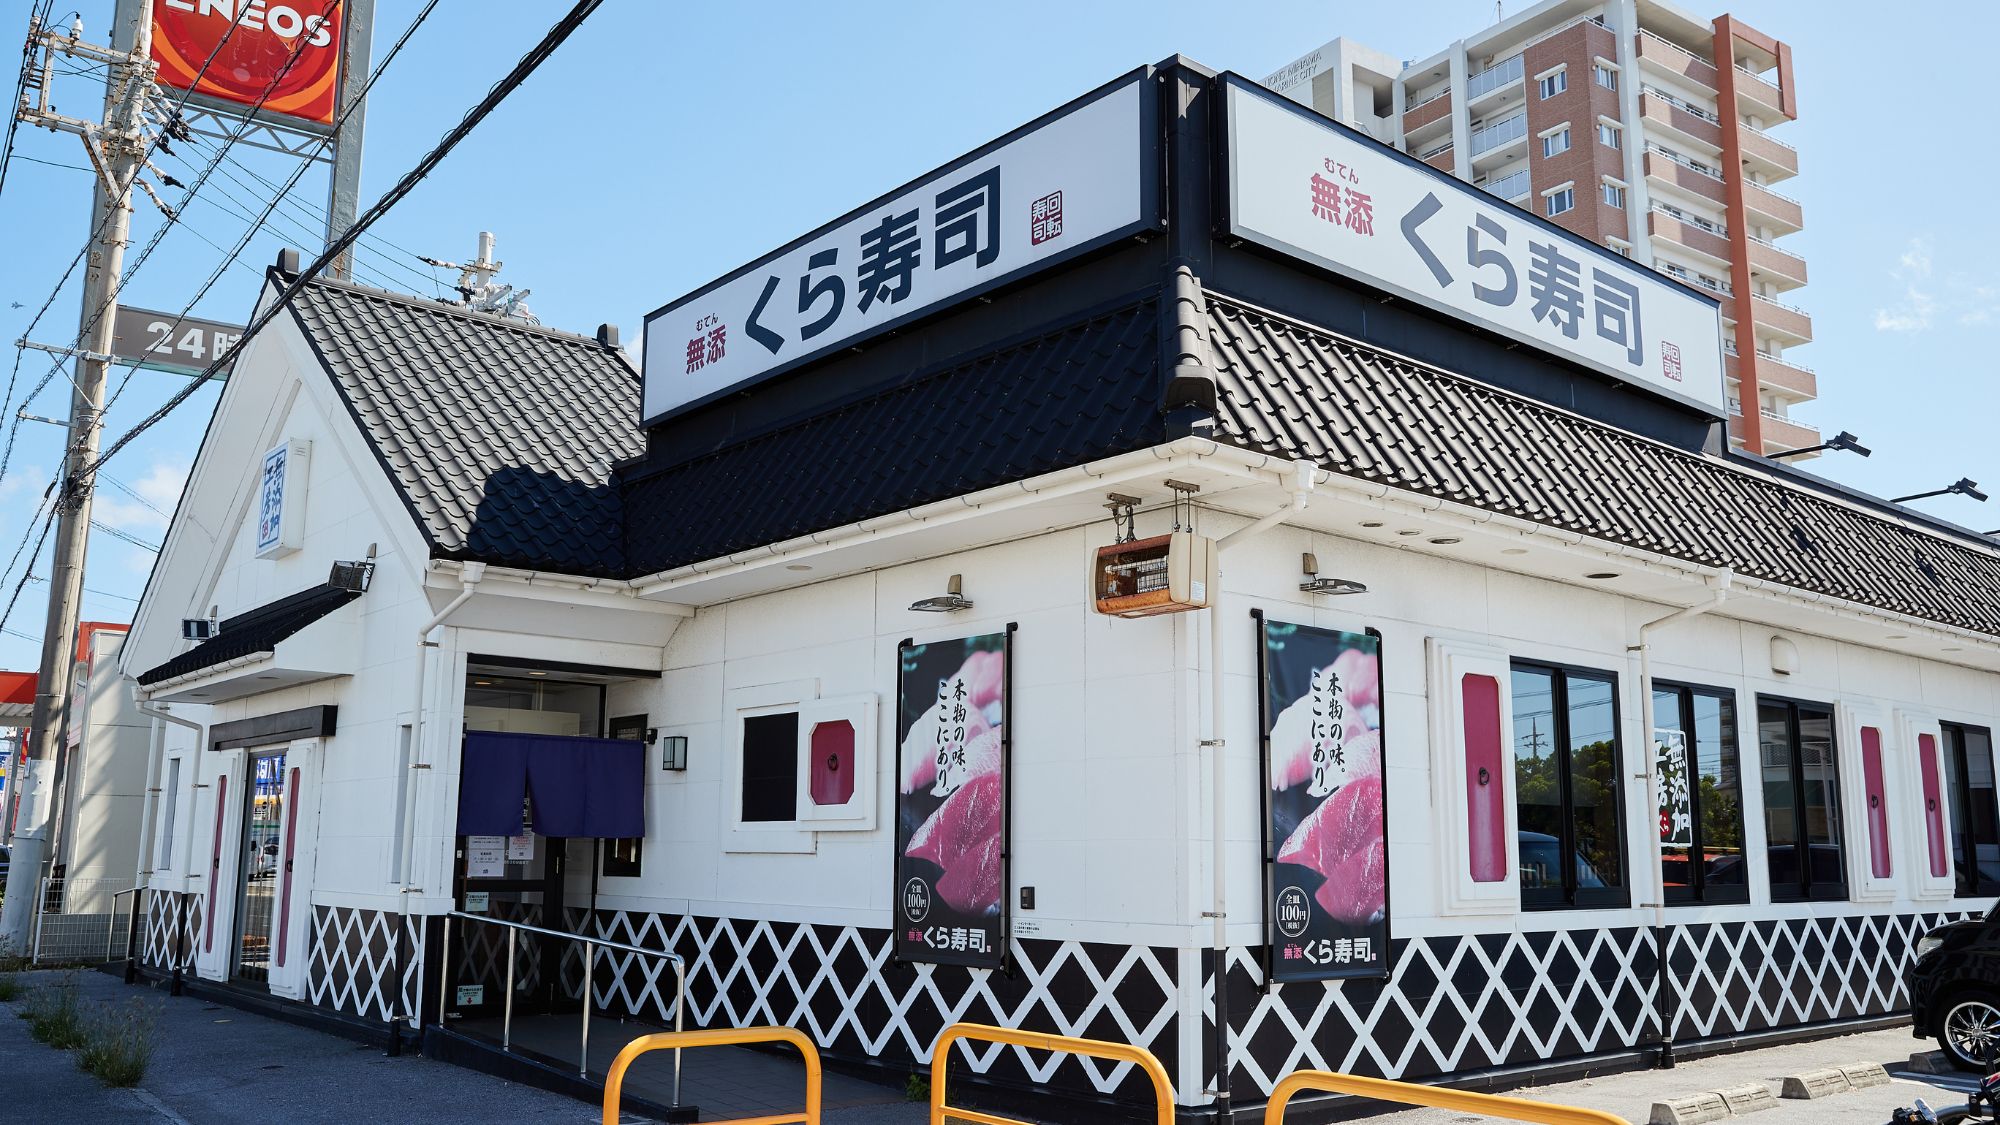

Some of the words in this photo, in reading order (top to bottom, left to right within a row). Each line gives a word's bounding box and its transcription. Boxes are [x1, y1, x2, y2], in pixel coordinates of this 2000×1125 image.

[1324, 157, 1359, 184] むてん
[685, 324, 726, 375] 無添
[744, 165, 1001, 355] くら寿司
[1310, 172, 1374, 237] 無添
[1400, 191, 1644, 367] くら寿司
[696, 312, 719, 332] むてん
[937, 682, 950, 793] ここにあり。
[952, 678, 967, 773] 本物の味。
[1311, 671, 1328, 793] ここにあり。
[1327, 672, 1346, 773] 本物の味。
[907, 893, 927, 908] 100円
[1280, 905, 1306, 921] 100円
[923, 925, 986, 953] くら寿司
[1303, 937, 1371, 965] くら寿司
